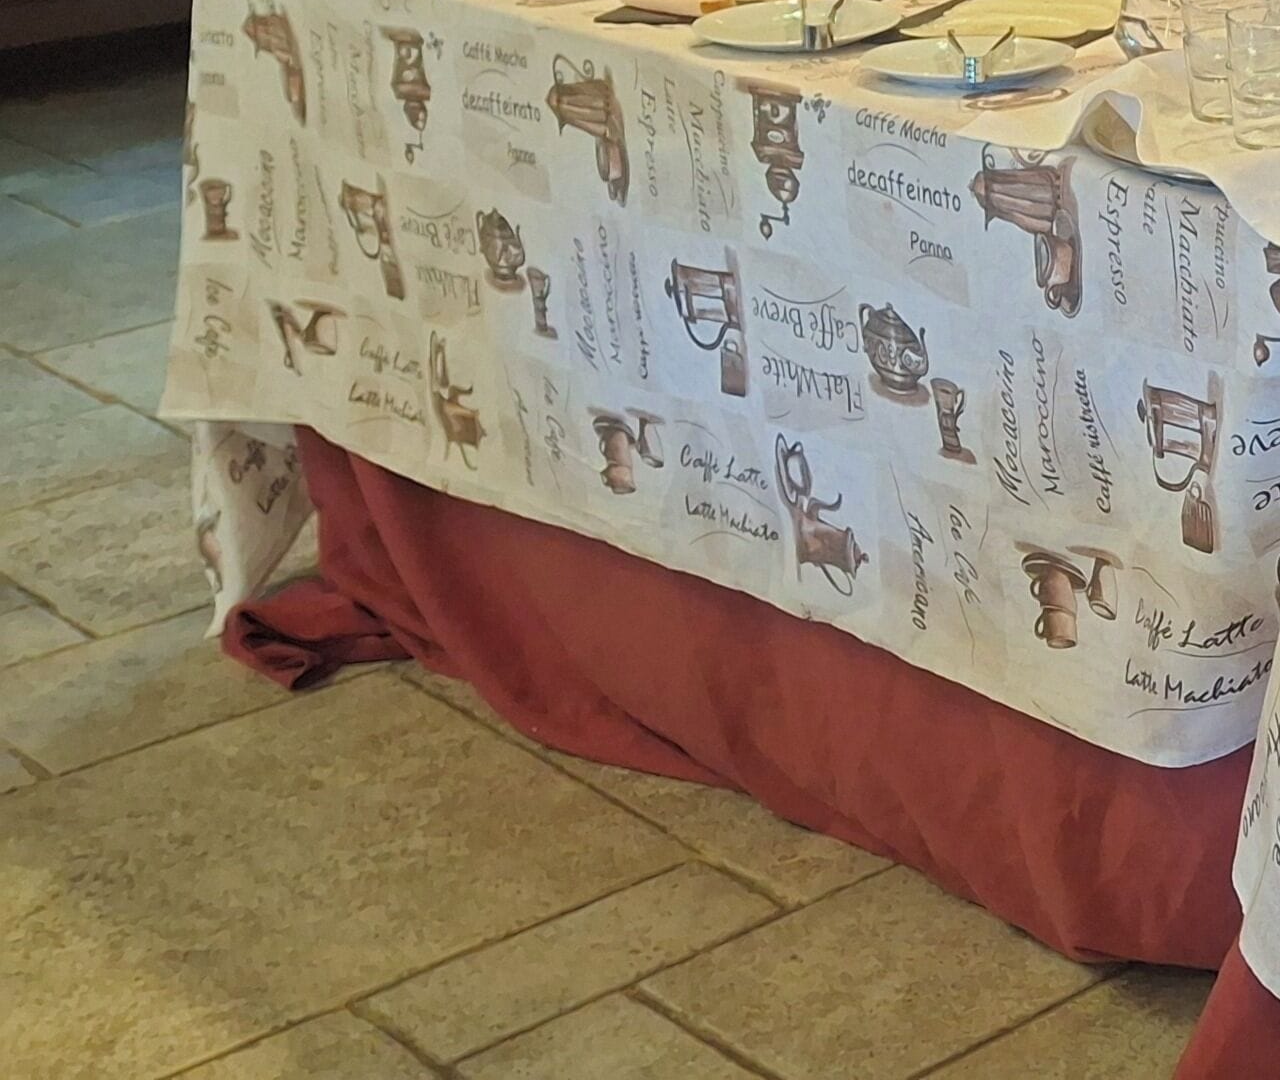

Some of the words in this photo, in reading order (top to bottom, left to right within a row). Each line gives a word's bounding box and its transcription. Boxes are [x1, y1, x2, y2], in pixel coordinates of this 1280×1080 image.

[855, 106, 898, 135] Caffé
[900, 118, 948, 149] Mocha
[847, 163, 962, 213] decaffeinato
[909, 230, 954, 261] Panna
[1098, 176, 1130, 306] Espresso
[1178, 194, 1203, 353] Macchiato
[751, 296, 805, 339] Breve
[810, 302, 860, 354] Caffé
[761, 355, 822, 400] White
[993, 348, 1031, 507] Mocaccino
[1031, 336, 1065, 496] Maroccino
[723, 456, 769, 491] Latte
[1086, 452, 1113, 515] Caffé
[906, 510, 935, 631] Americano
